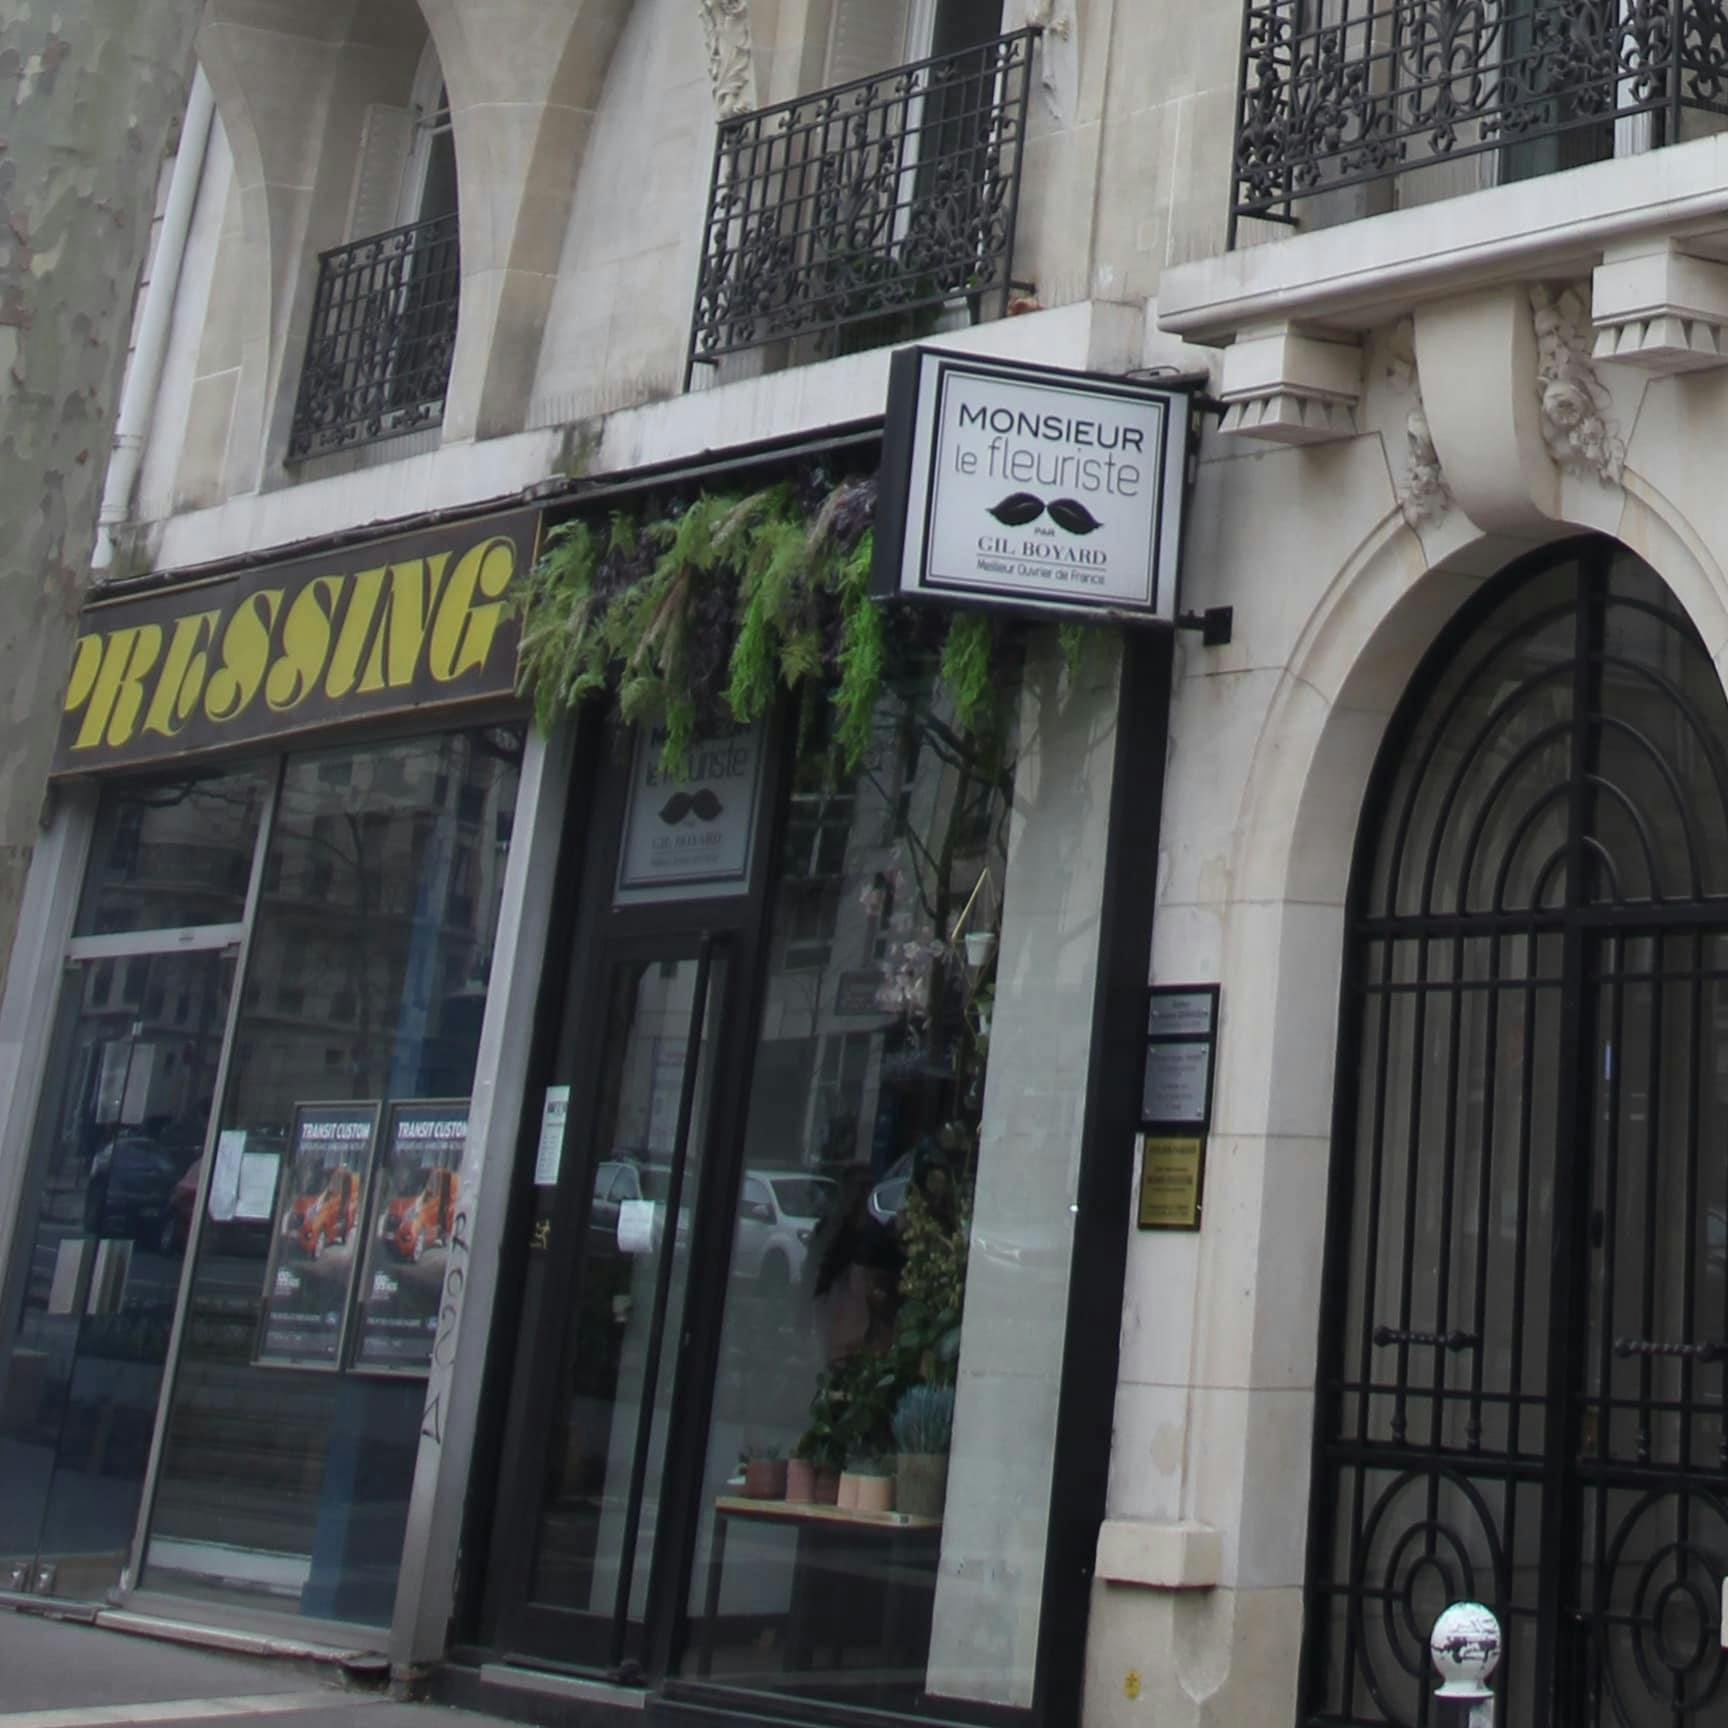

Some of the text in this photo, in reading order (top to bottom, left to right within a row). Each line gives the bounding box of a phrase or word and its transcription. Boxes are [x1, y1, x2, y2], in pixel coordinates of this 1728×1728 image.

[959, 403, 1144, 453] MONSIEUR
[955, 437, 1141, 497] le fleuriste
[1034, 527, 1056, 537] PAR
[978, 536, 1107, 565] GIL BOYARD
[977, 558, 1105, 584] Meilleur Ouvrier de France
[302, 1121, 371, 1140] TRANSIT CUSTOM
[397, 1121, 434, 1139] TRANSIT
